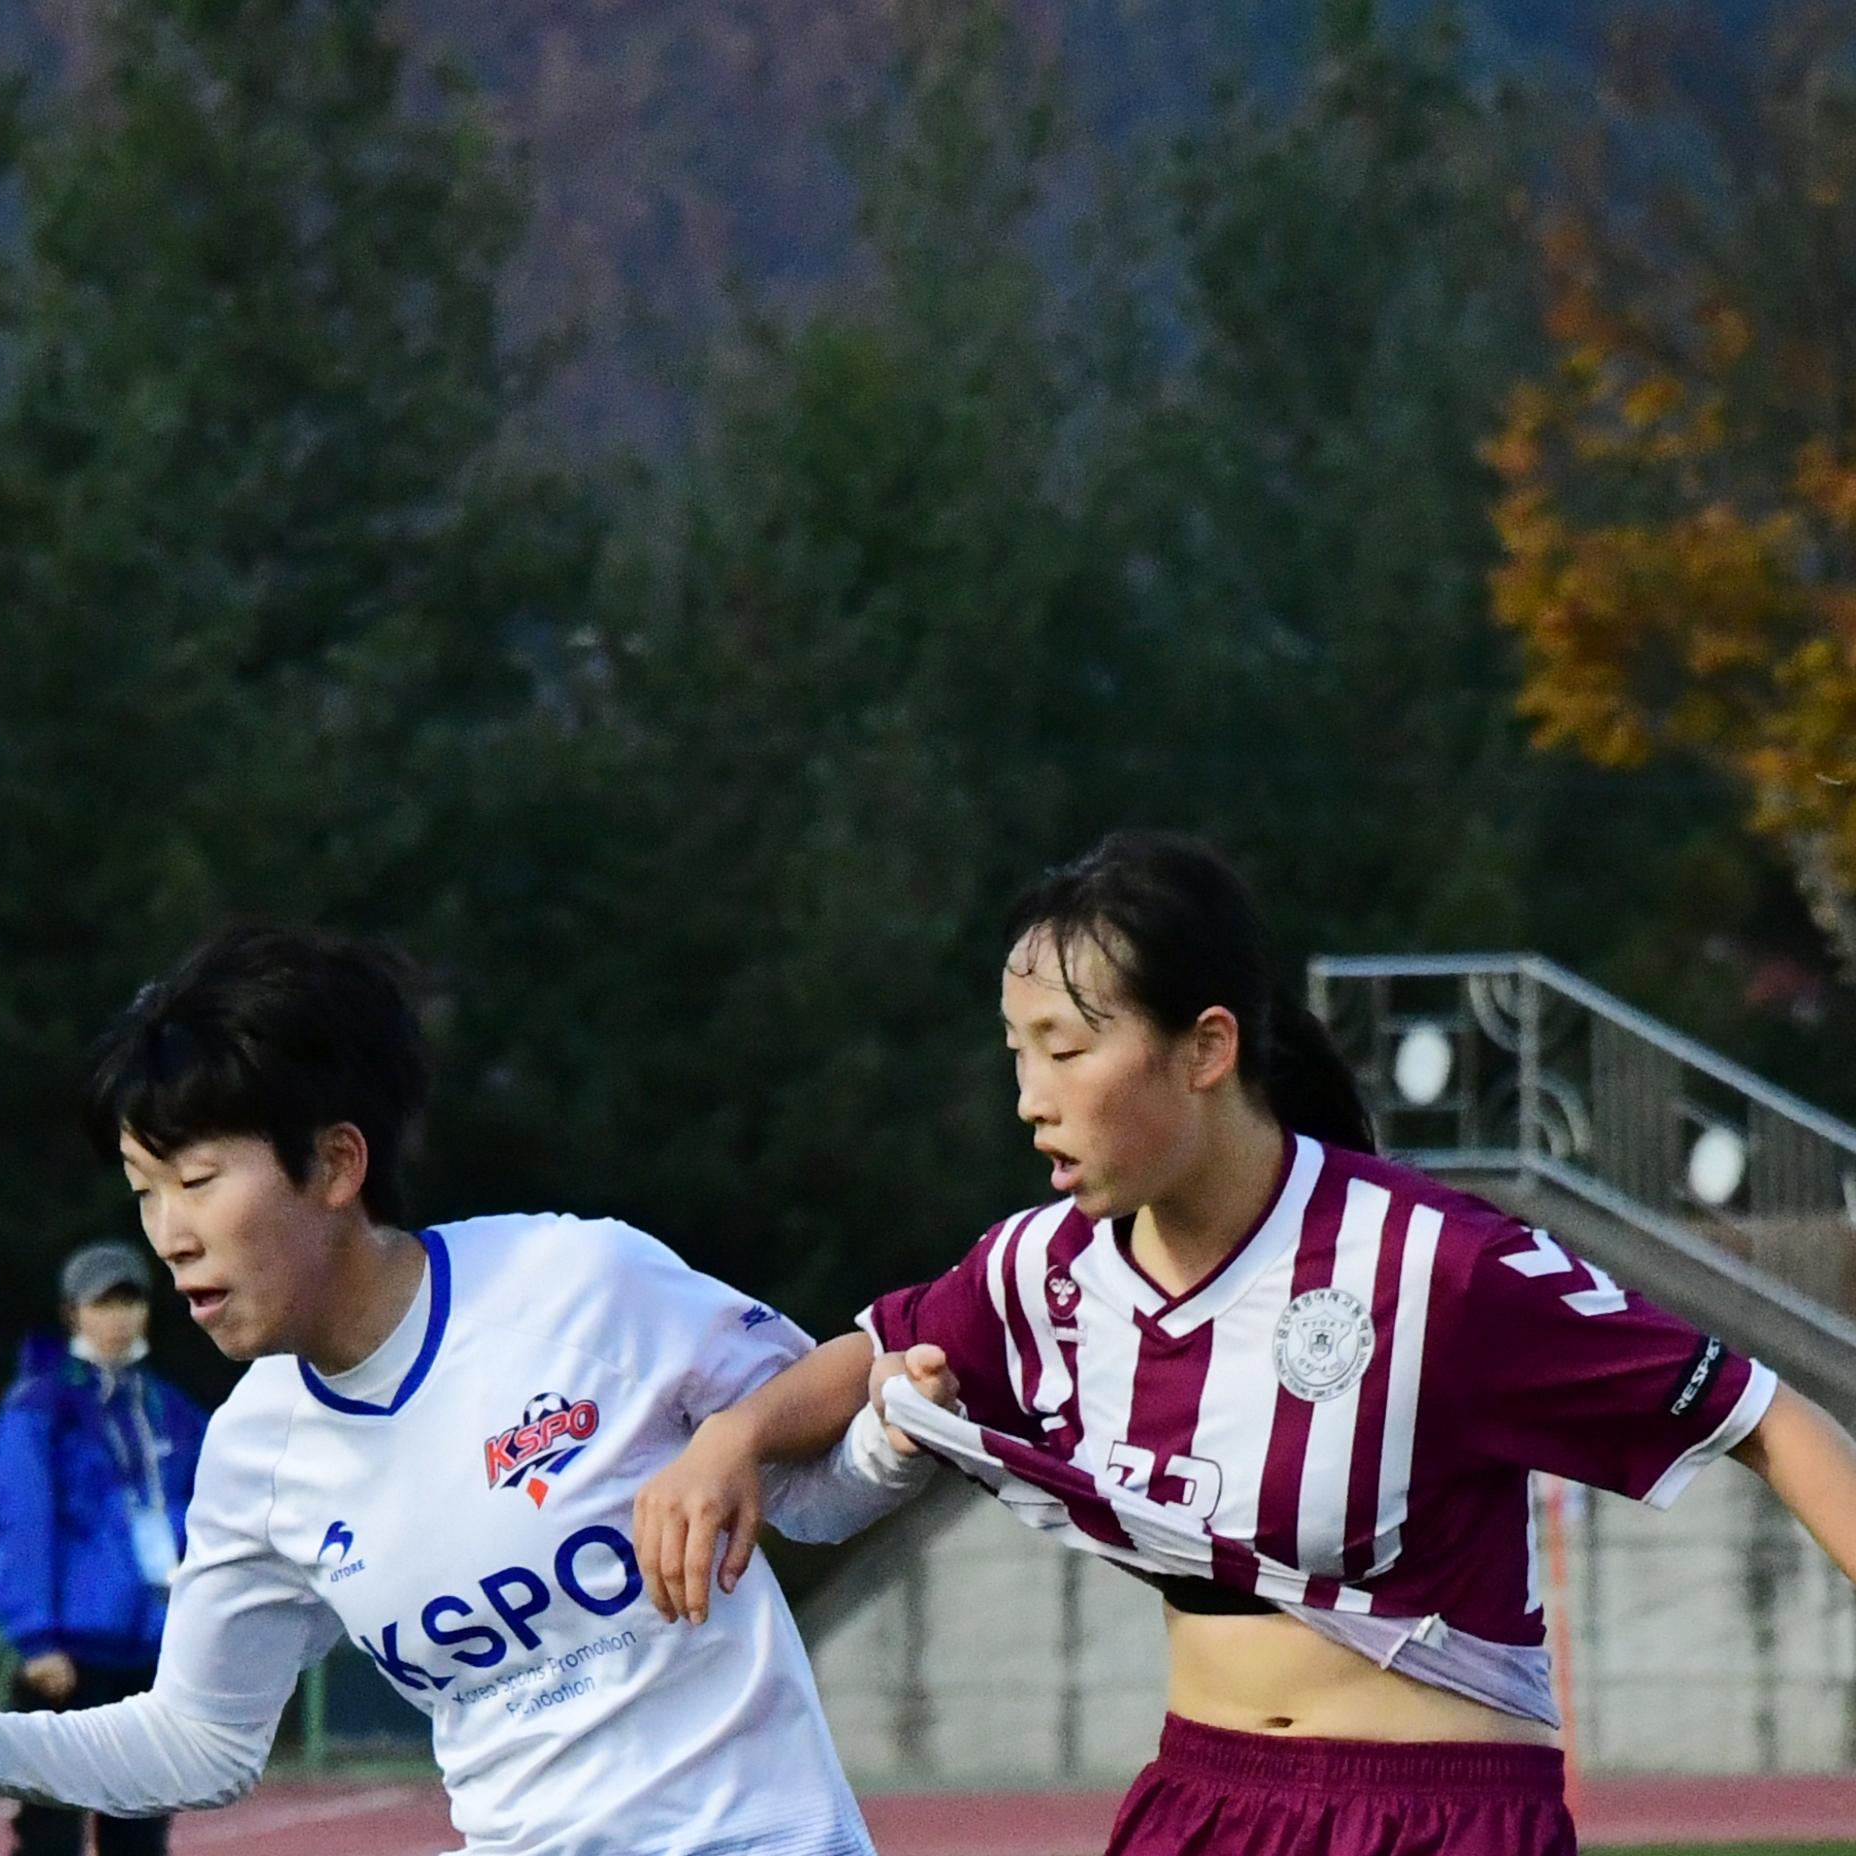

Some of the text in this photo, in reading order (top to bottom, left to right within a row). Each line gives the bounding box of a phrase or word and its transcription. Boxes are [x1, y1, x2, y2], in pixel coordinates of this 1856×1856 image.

[485, 1400, 599, 1490] KSPO
[359, 1525, 643, 1691] KSPO
[547, 1631, 637, 1680] Promotion
